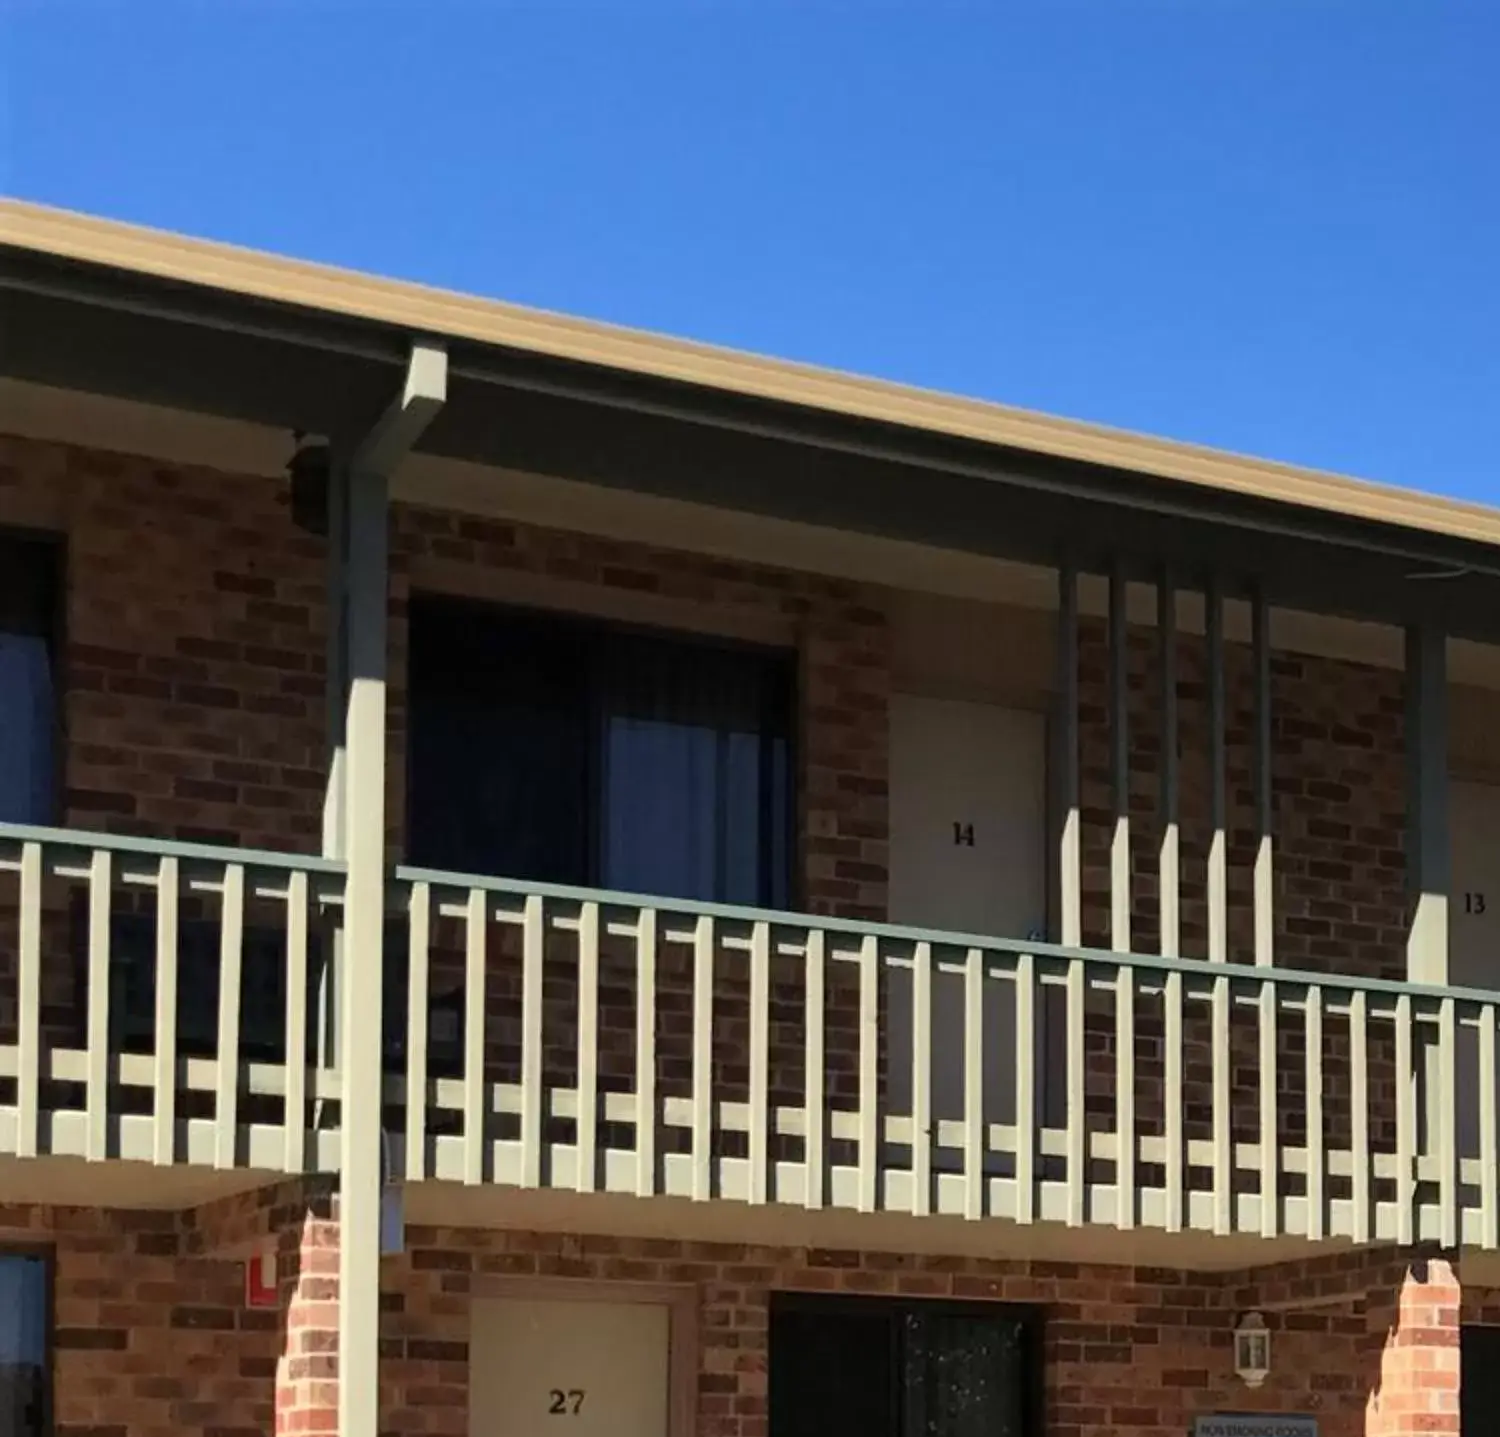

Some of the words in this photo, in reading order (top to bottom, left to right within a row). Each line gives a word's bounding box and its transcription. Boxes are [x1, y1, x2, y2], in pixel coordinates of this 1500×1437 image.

[953, 821, 974, 846] 14
[1465, 892, 1485, 914] 13
[549, 1389, 585, 1415] 27
